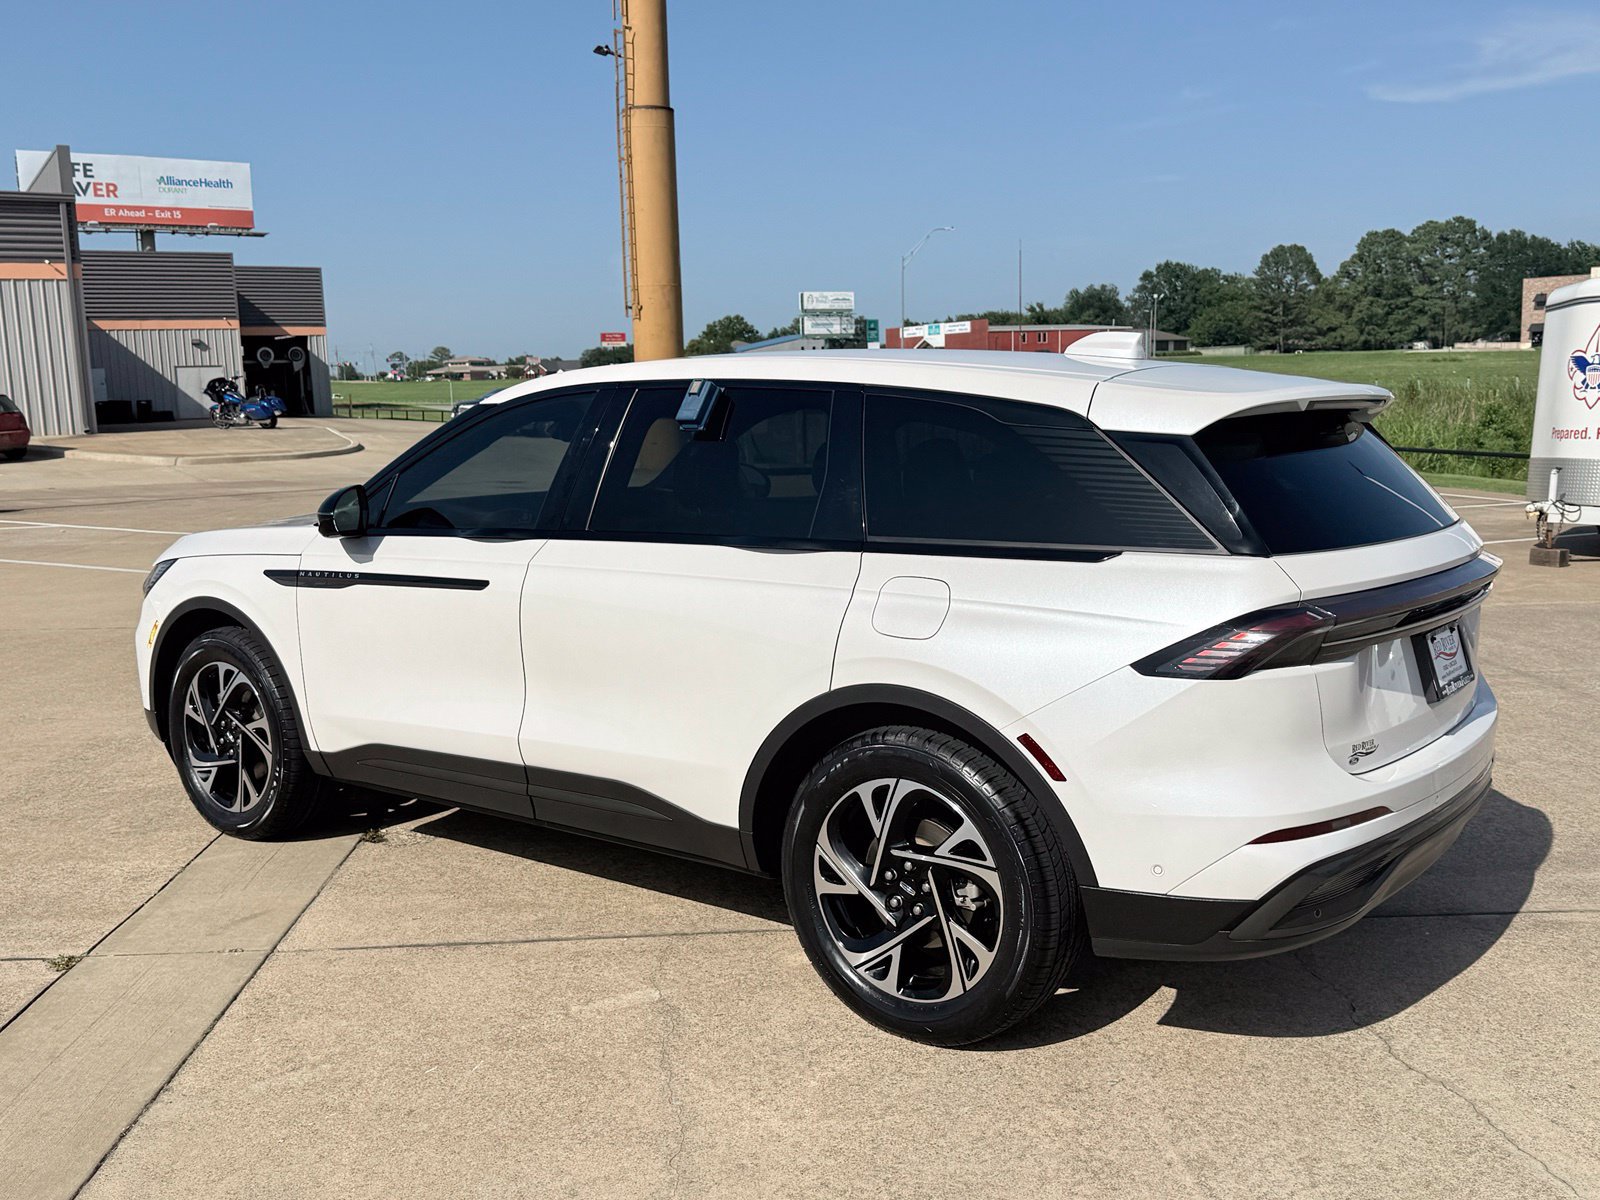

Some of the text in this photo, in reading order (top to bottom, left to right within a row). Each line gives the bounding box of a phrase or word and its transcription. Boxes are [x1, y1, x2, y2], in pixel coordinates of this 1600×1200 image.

[71, 162, 95, 178] FE
[157, 176, 233, 189] AllianceHealth
[158, 186, 187, 194] DURANT
[104, 208, 117, 216] ER
[118, 208, 145, 217] Ahead
[154, 209, 172, 218] Exit
[172, 210, 182, 219] 15
[299, 571, 360, 579] NAUTILUS
